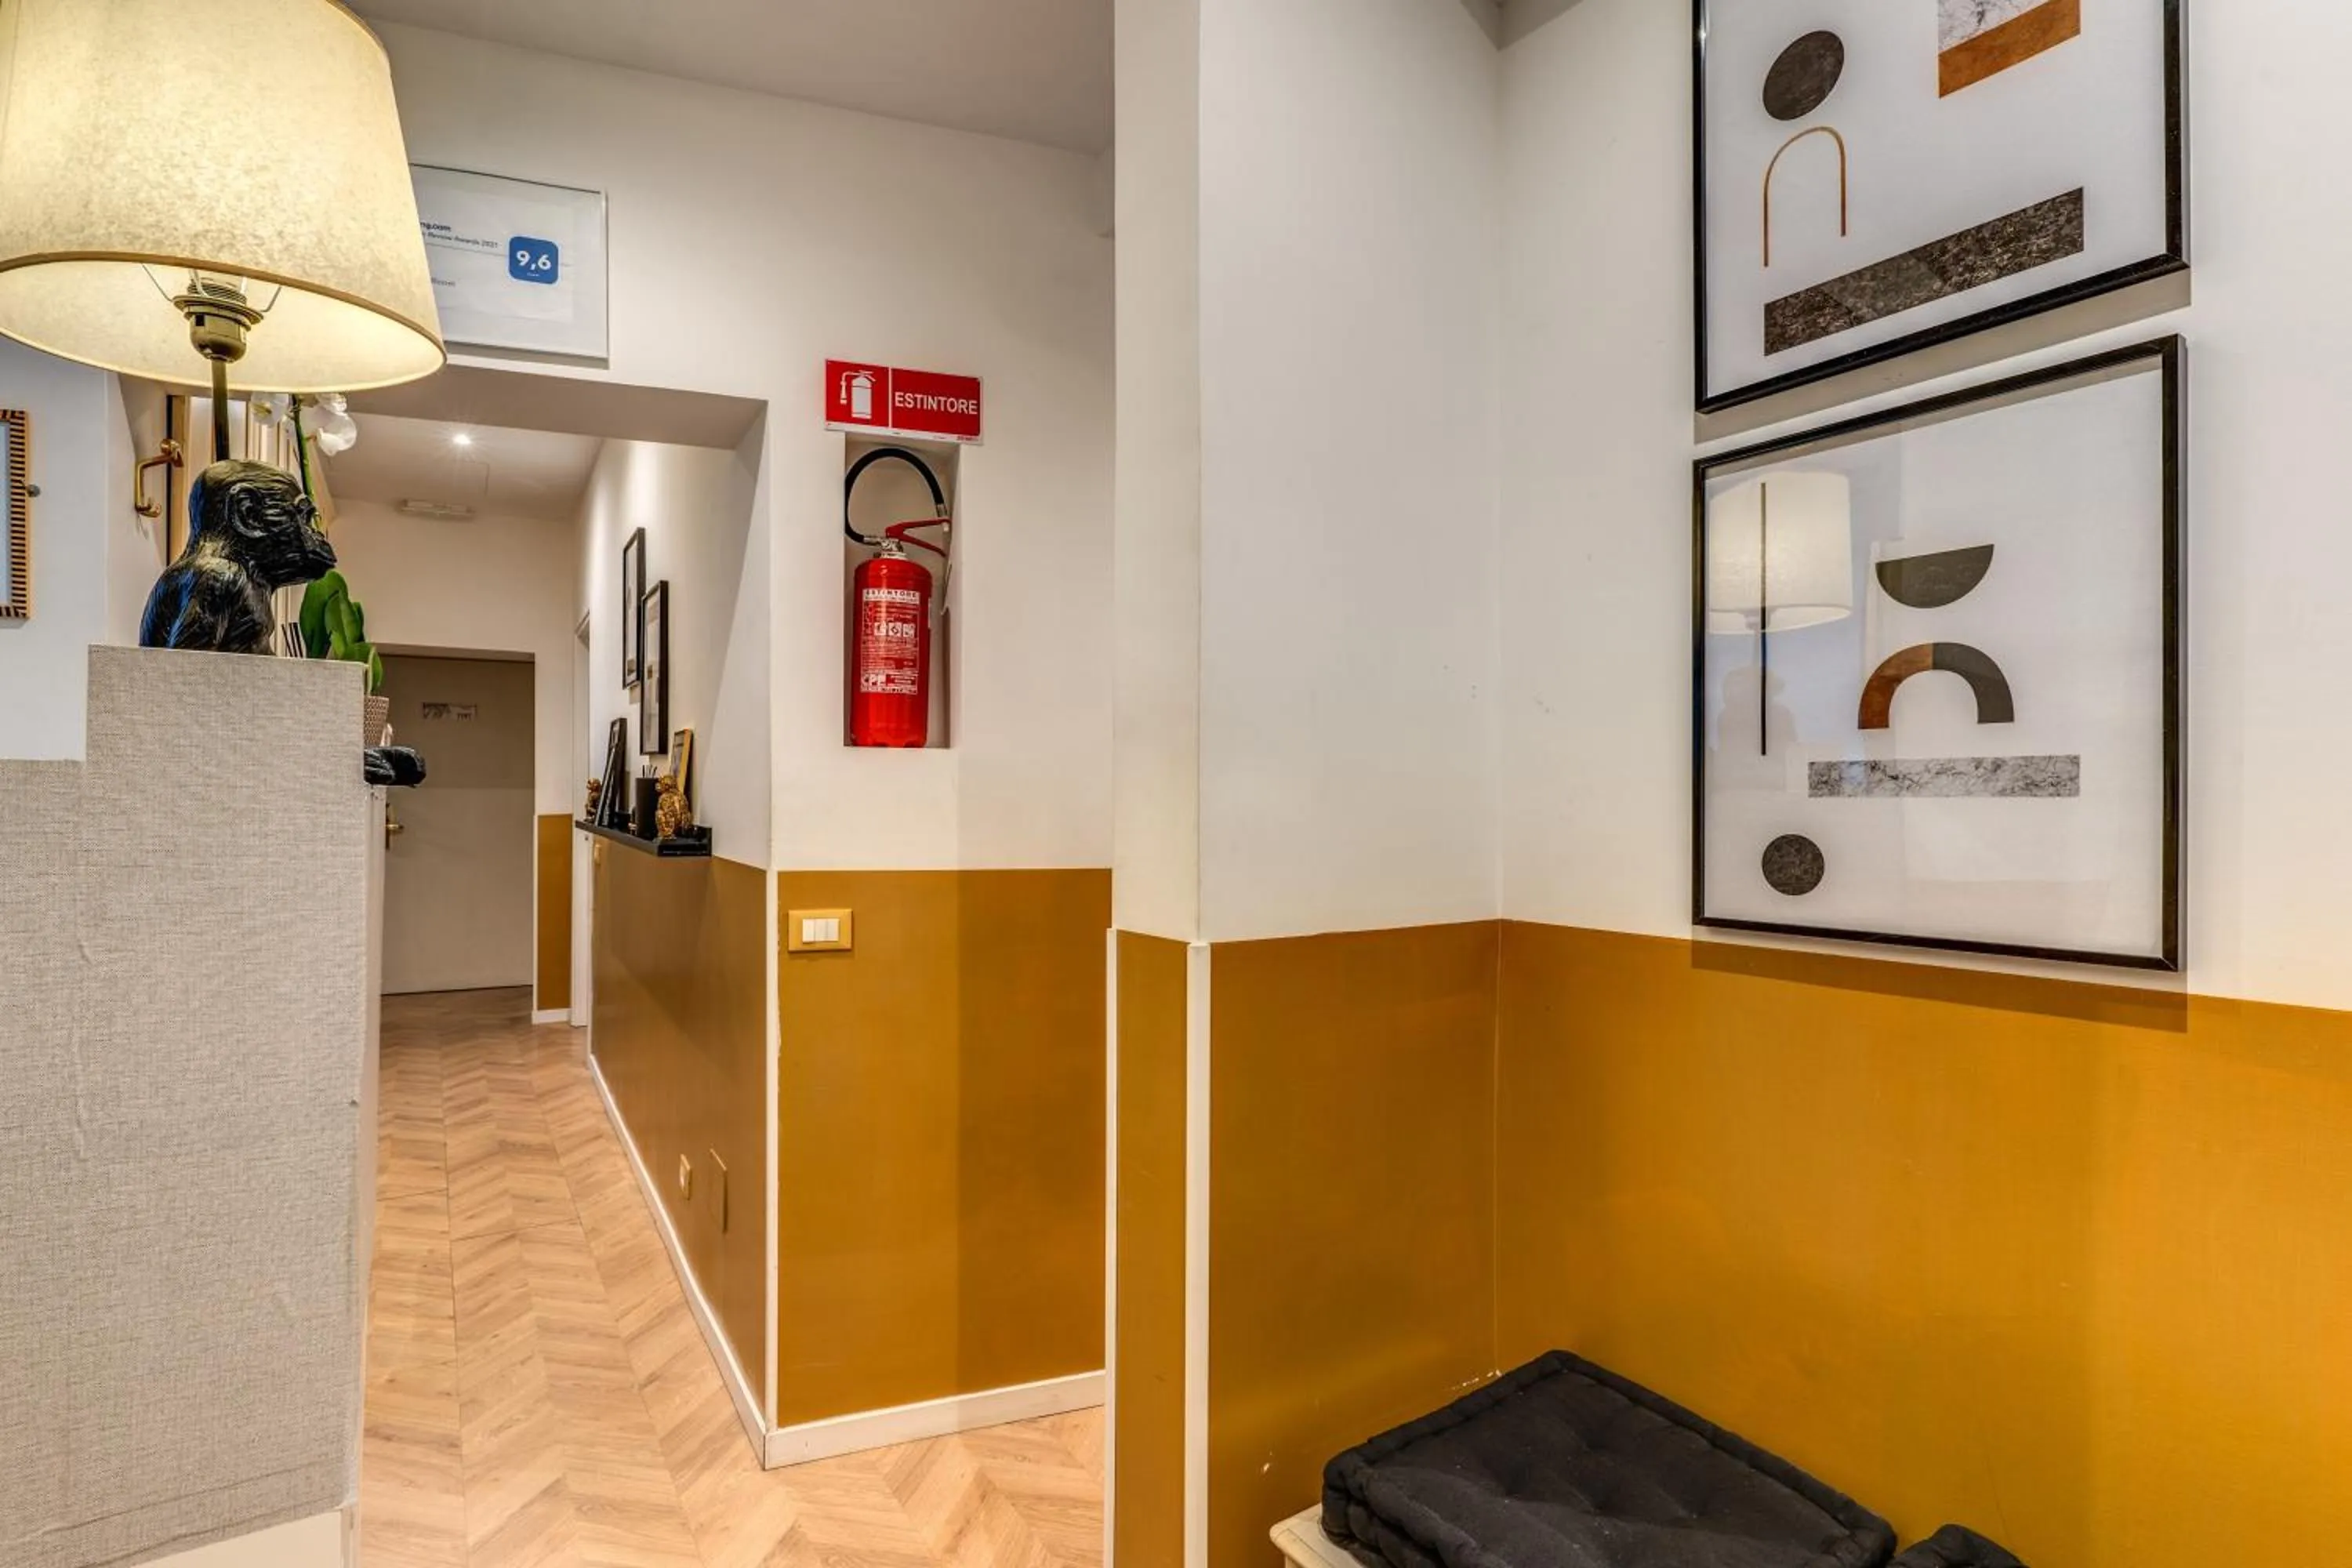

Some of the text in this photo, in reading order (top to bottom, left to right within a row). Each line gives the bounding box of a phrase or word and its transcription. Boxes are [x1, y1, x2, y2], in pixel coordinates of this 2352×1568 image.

[420, 222, 452, 232] ng.com
[517, 250, 551, 270] 9,6
[895, 391, 978, 416] ESTINTORE
